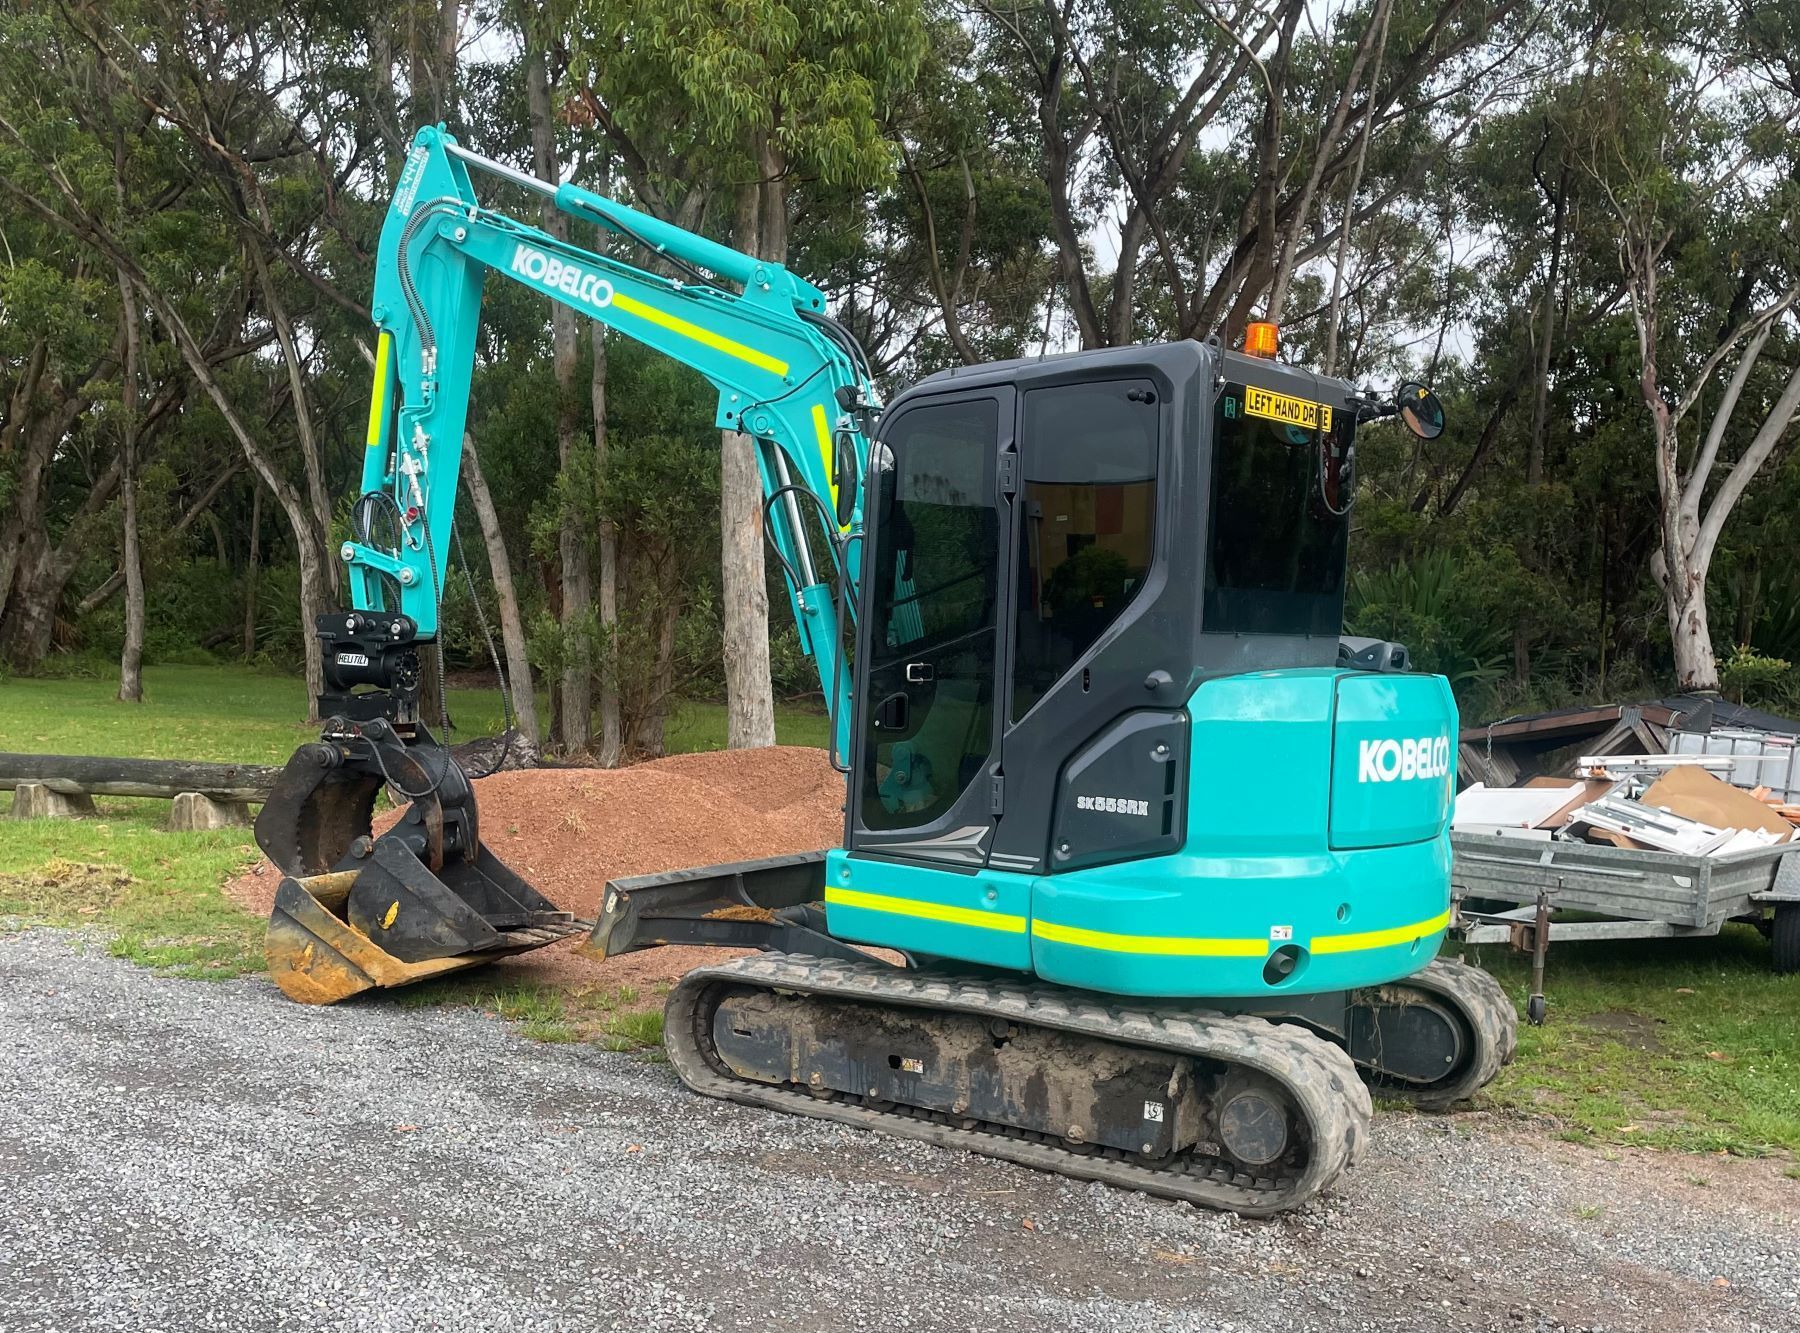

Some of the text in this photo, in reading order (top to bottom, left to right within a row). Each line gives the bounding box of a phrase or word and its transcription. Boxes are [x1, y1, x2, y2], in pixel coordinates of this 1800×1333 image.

[511, 244, 614, 308] KOBELCO
[1249, 392, 1328, 426] LEFT HAND DRIE
[1358, 736, 1449, 783] KOBELCO
[1077, 796, 1149, 816] SK55SRX
